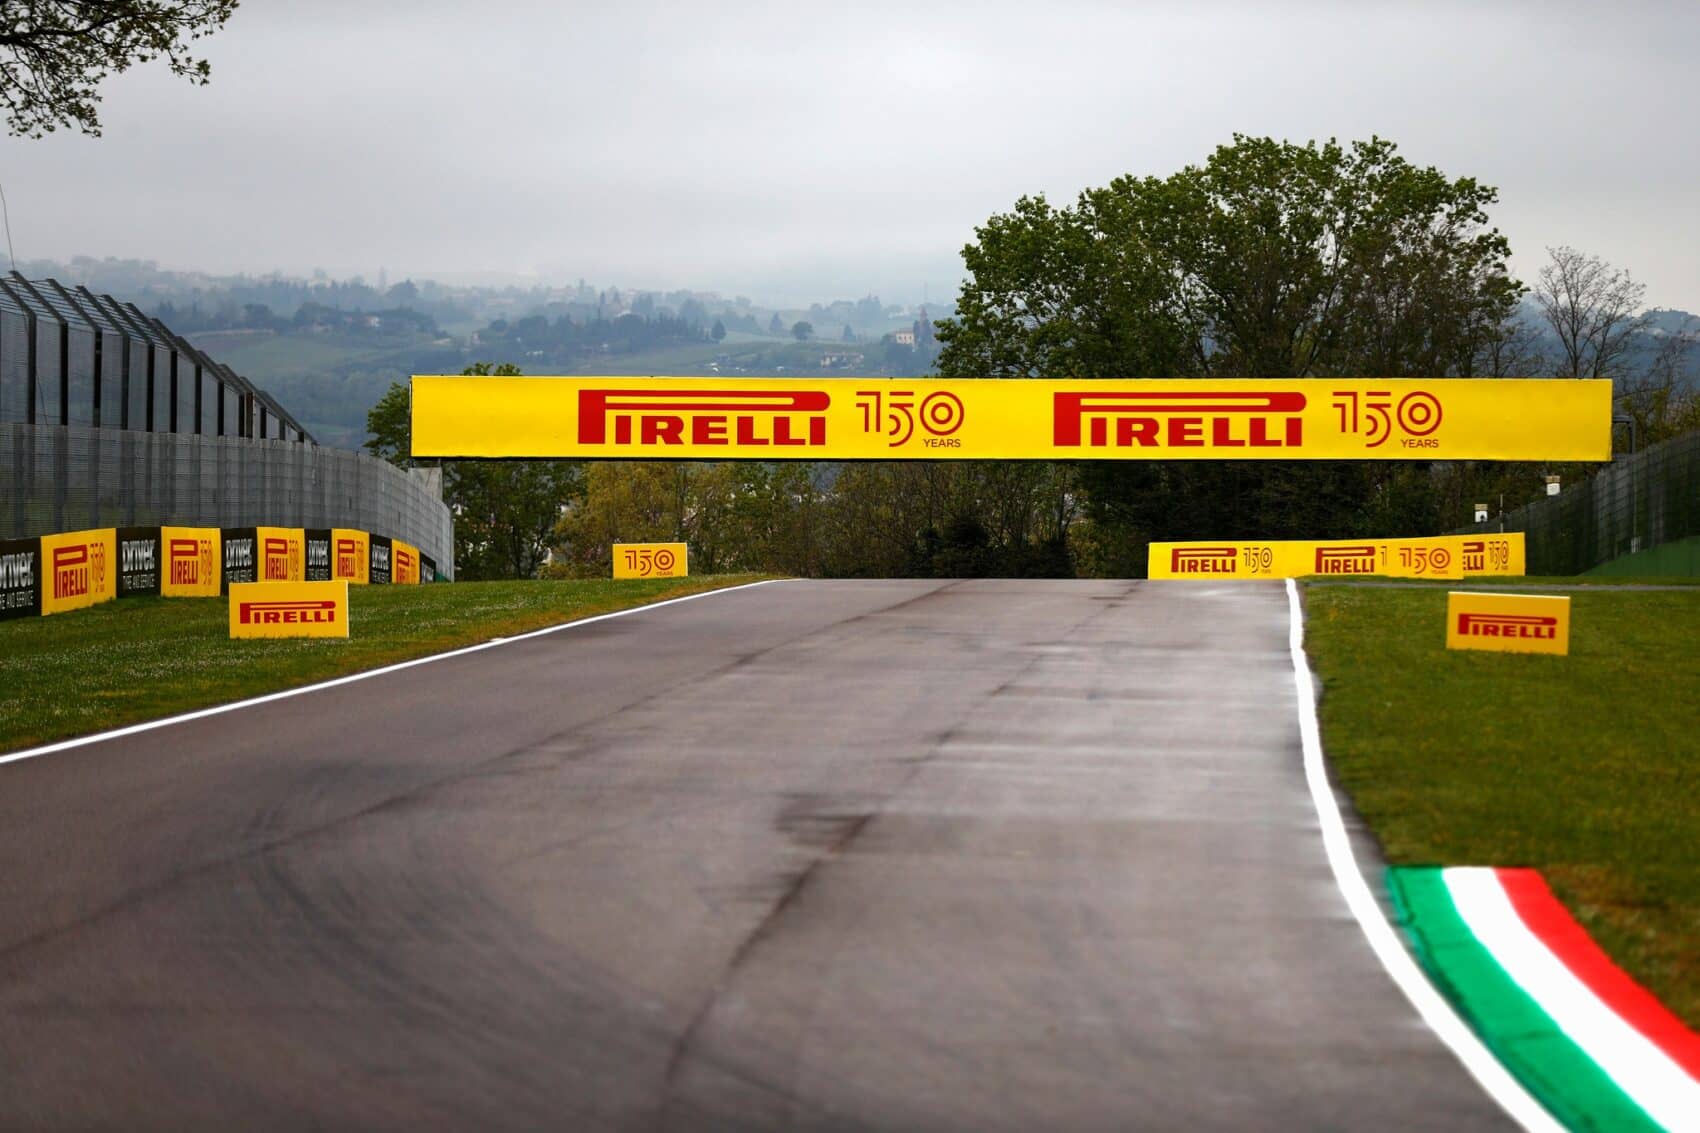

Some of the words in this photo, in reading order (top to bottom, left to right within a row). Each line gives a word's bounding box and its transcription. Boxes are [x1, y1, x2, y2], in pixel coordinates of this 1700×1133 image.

[578, 389, 830, 446] PIRELLI
[856, 391, 965, 448] 150
[1053, 391, 1307, 447] PIRELLI
[1332, 391, 1442, 448] 150
[923, 438, 962, 448] YEARS
[1400, 438, 1440, 449] YEARS
[53, 543, 88, 600] PIRELLI
[624, 549, 675, 576] 150
[1171, 547, 1237, 573] PIRELLI
[1243, 547, 1272, 574] 150
[1315, 546, 1376, 574] PIRELLI
[1399, 547, 1451, 574] 150
[240, 601, 336, 624] PIRELLI
[1458, 613, 1557, 639] PIRELLI
